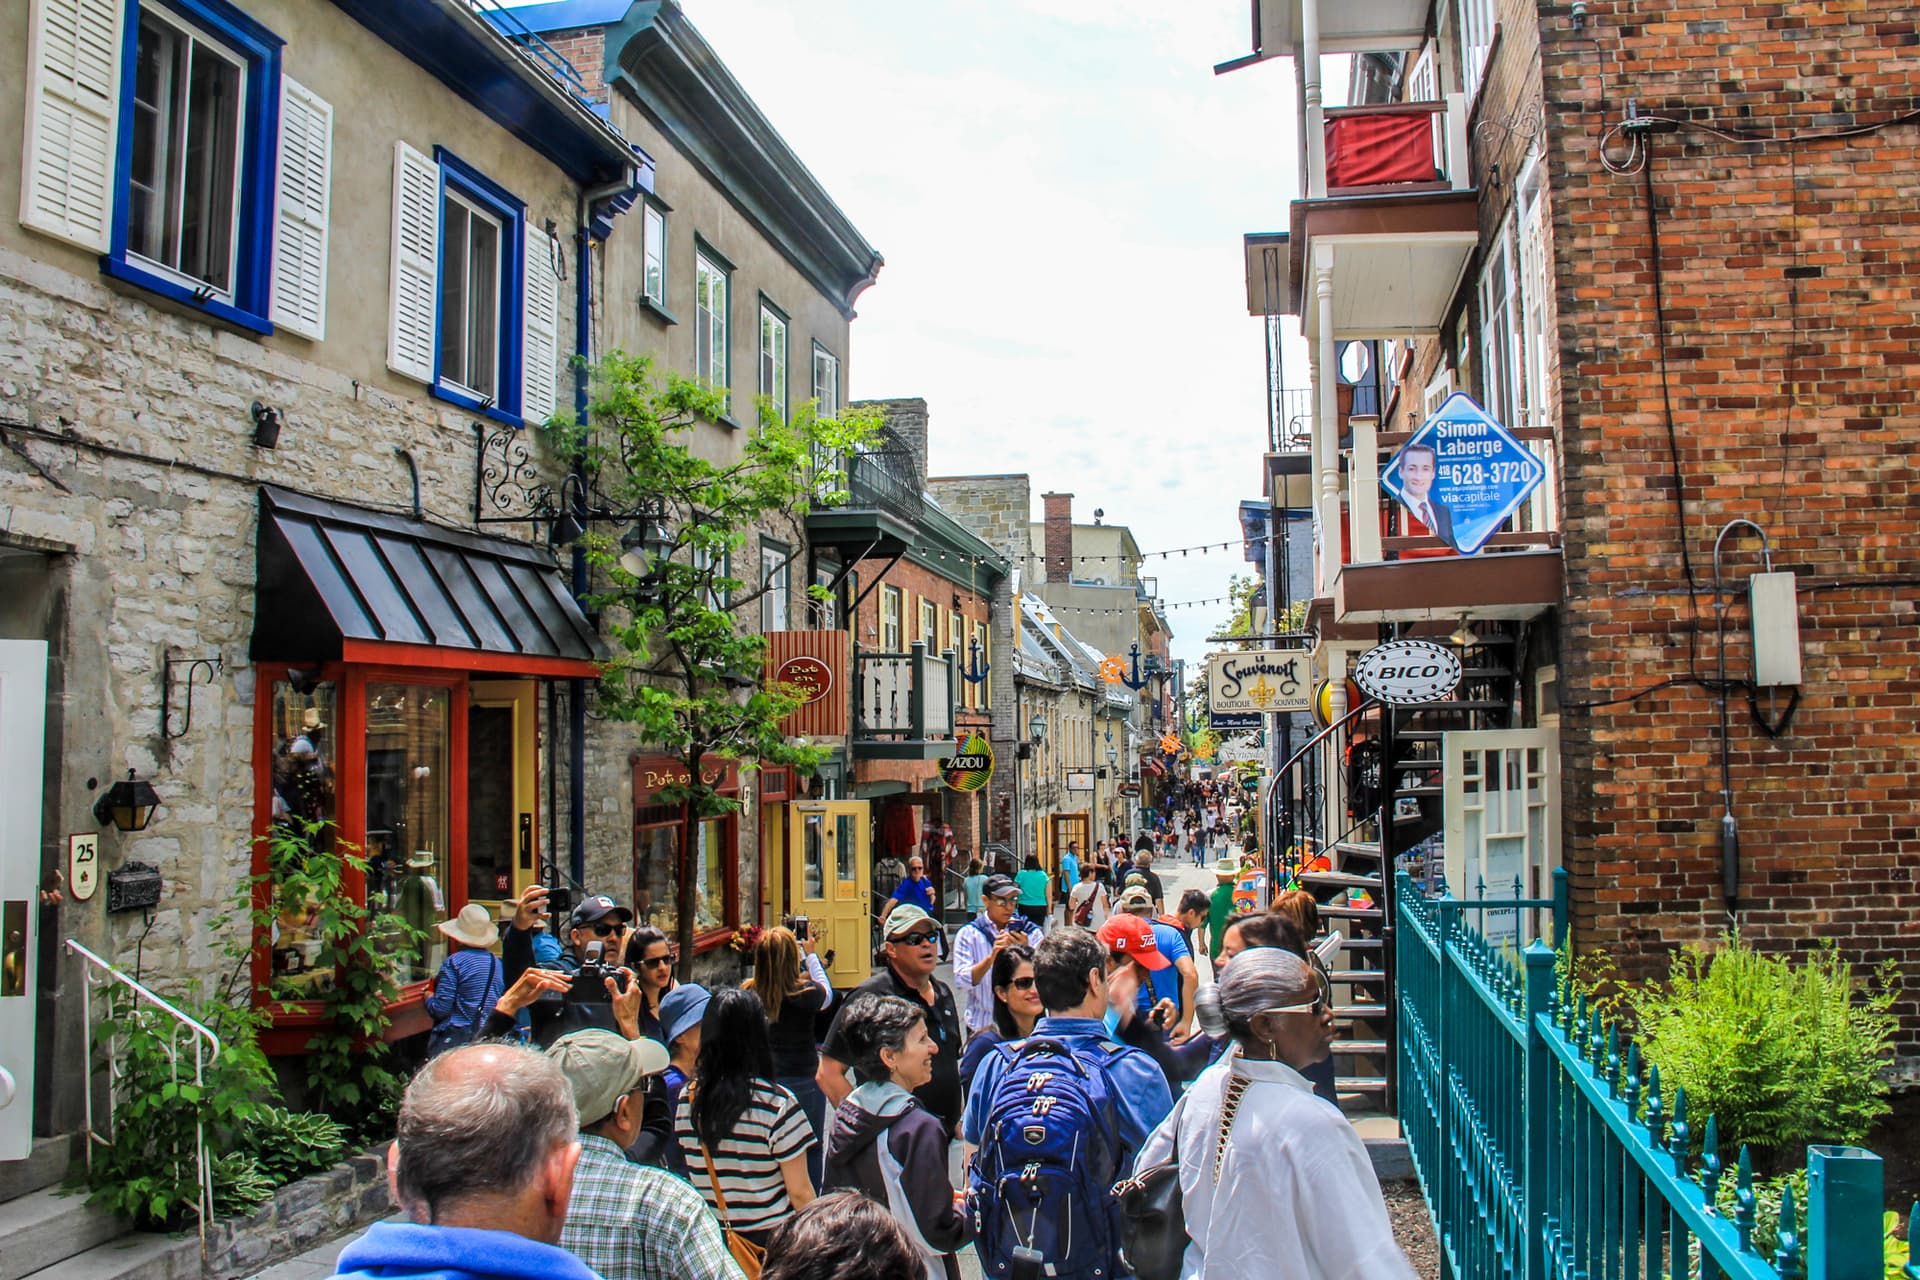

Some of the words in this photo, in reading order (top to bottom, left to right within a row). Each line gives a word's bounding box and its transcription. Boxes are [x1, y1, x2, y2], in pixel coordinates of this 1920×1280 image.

[1437, 421, 1487, 438] Simon
[1437, 438, 1502, 457] Laberge
[1439, 464, 1450, 476] 418
[1452, 461, 1530, 486] 628-3720
[1441, 490, 1500, 503] viacapitale
[1379, 665, 1440, 679] BICO
[1216, 700, 1250, 709] BOUTIQUE
[1274, 698, 1308, 706] SOUVENIRS
[946, 756, 984, 769] ZAZOU
[76, 843, 94, 863] 25
